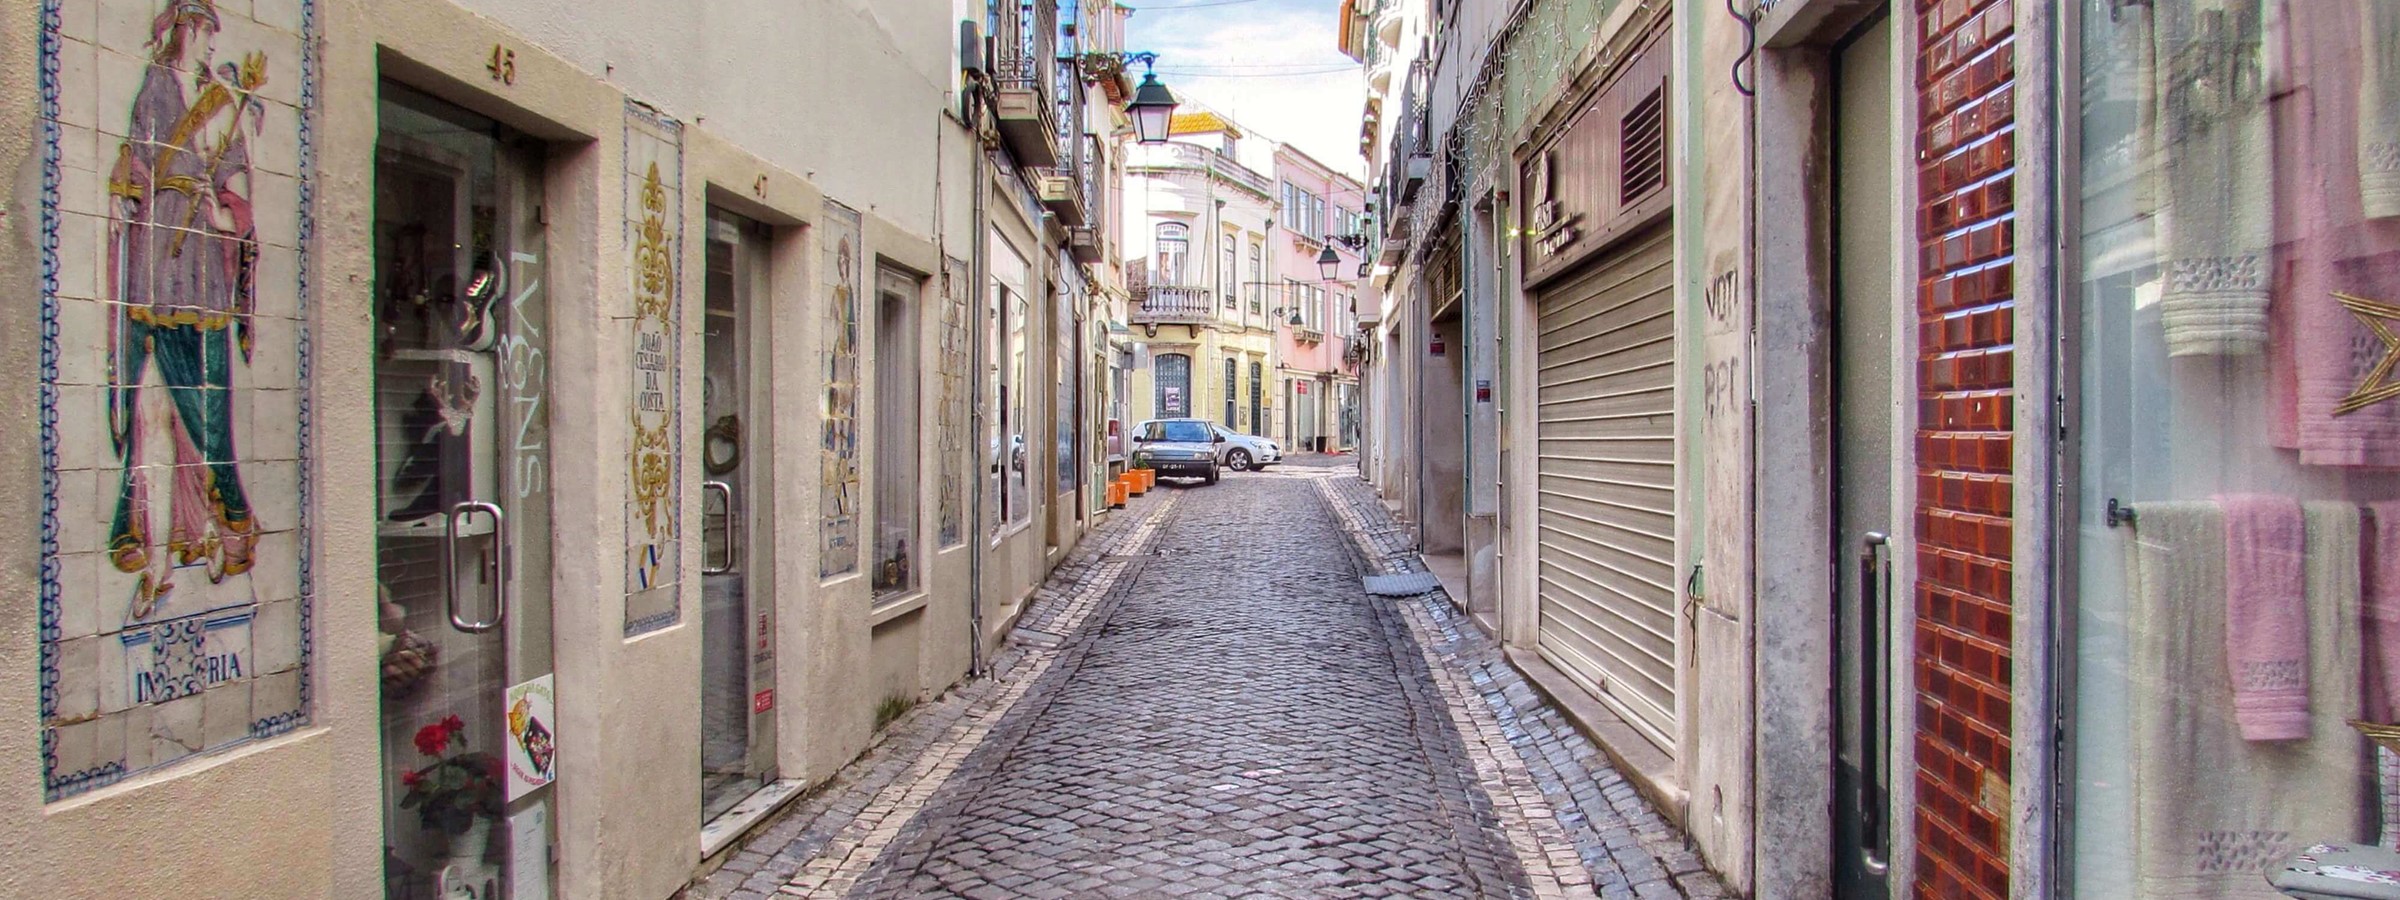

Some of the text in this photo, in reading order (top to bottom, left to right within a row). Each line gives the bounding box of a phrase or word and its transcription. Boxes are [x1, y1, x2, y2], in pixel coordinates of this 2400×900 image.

[486, 43, 515, 86] 45
[753, 173, 768, 199] 47
[640, 331, 662, 352] JOÃO
[645, 371, 659, 391] DA
[640, 391, 665, 412] COSTA
